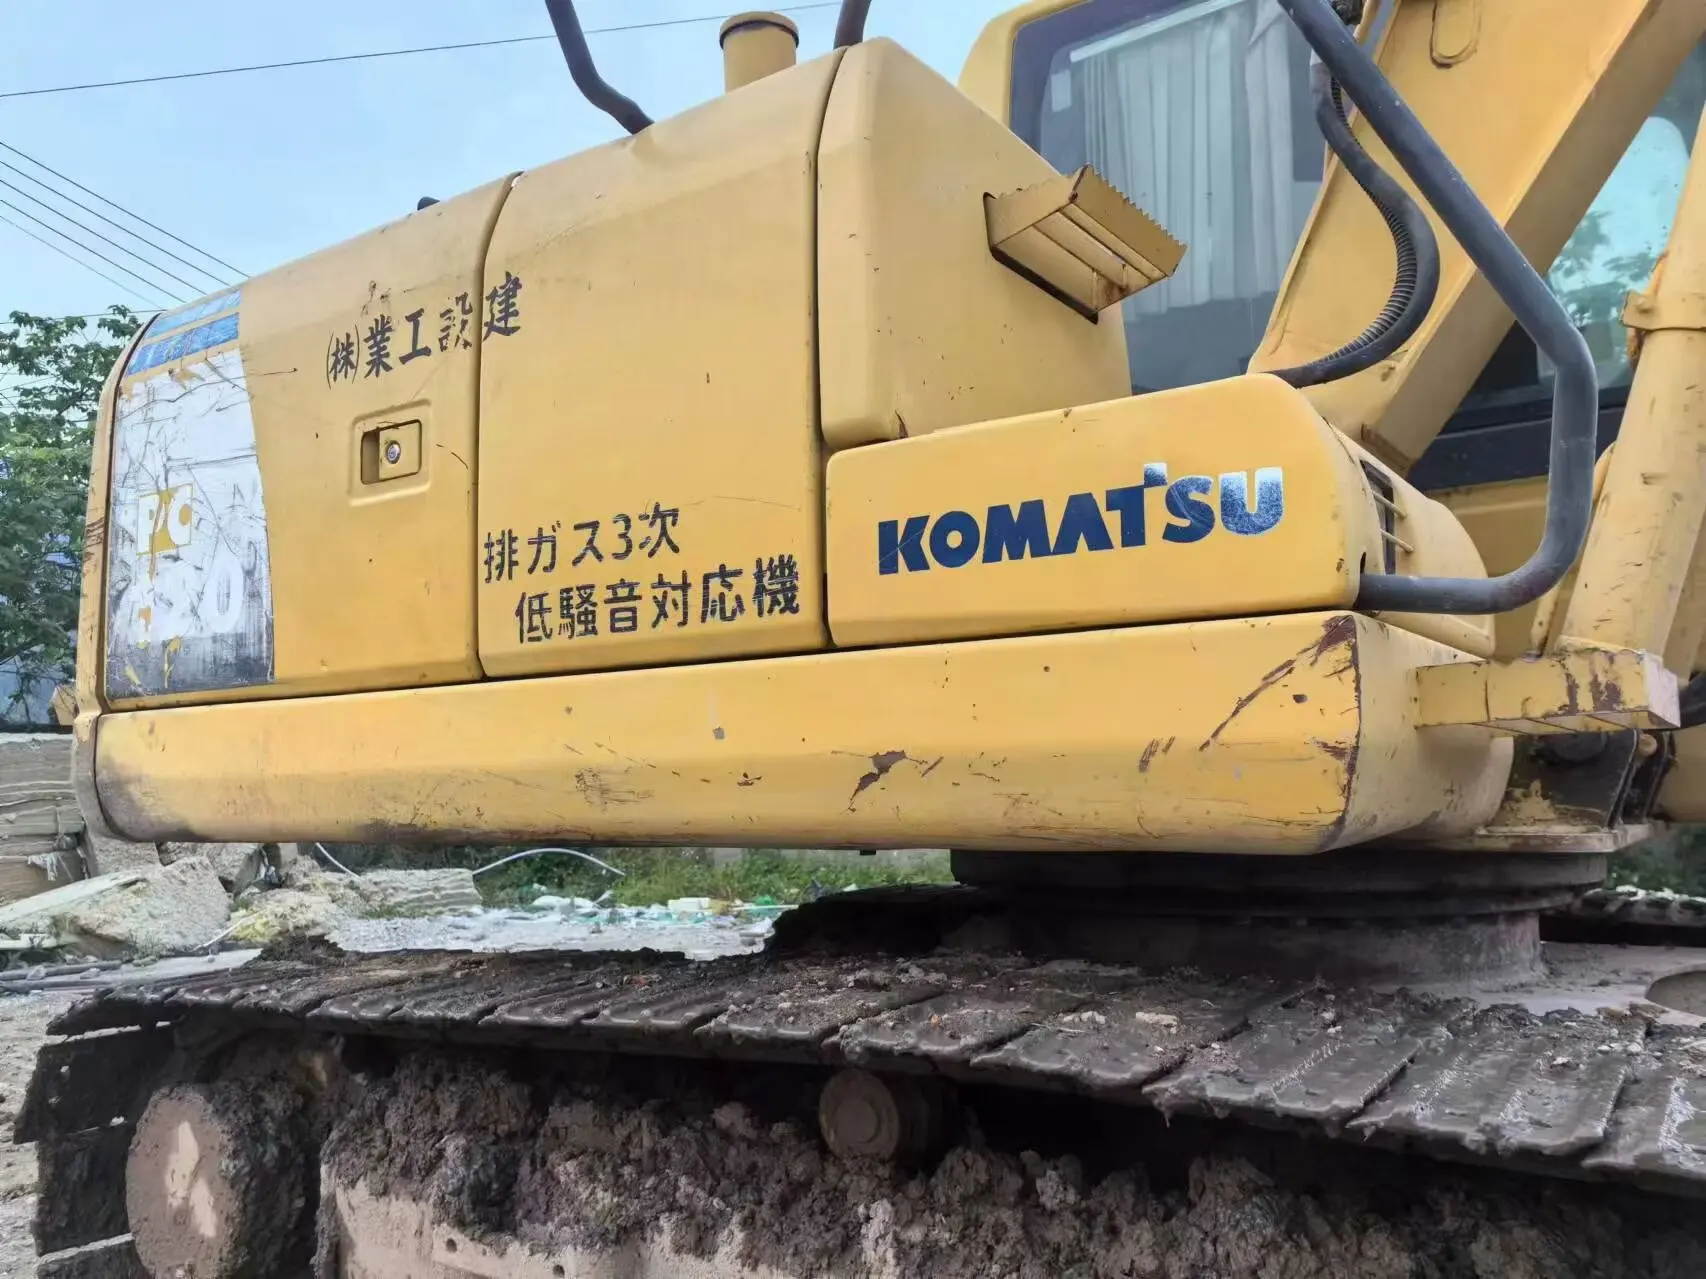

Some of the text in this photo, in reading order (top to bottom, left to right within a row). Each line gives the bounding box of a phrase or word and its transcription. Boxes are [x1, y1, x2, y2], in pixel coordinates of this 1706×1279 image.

[484, 502, 680, 584] 排ガス3次
[878, 462, 1284, 576] KOMATSU
